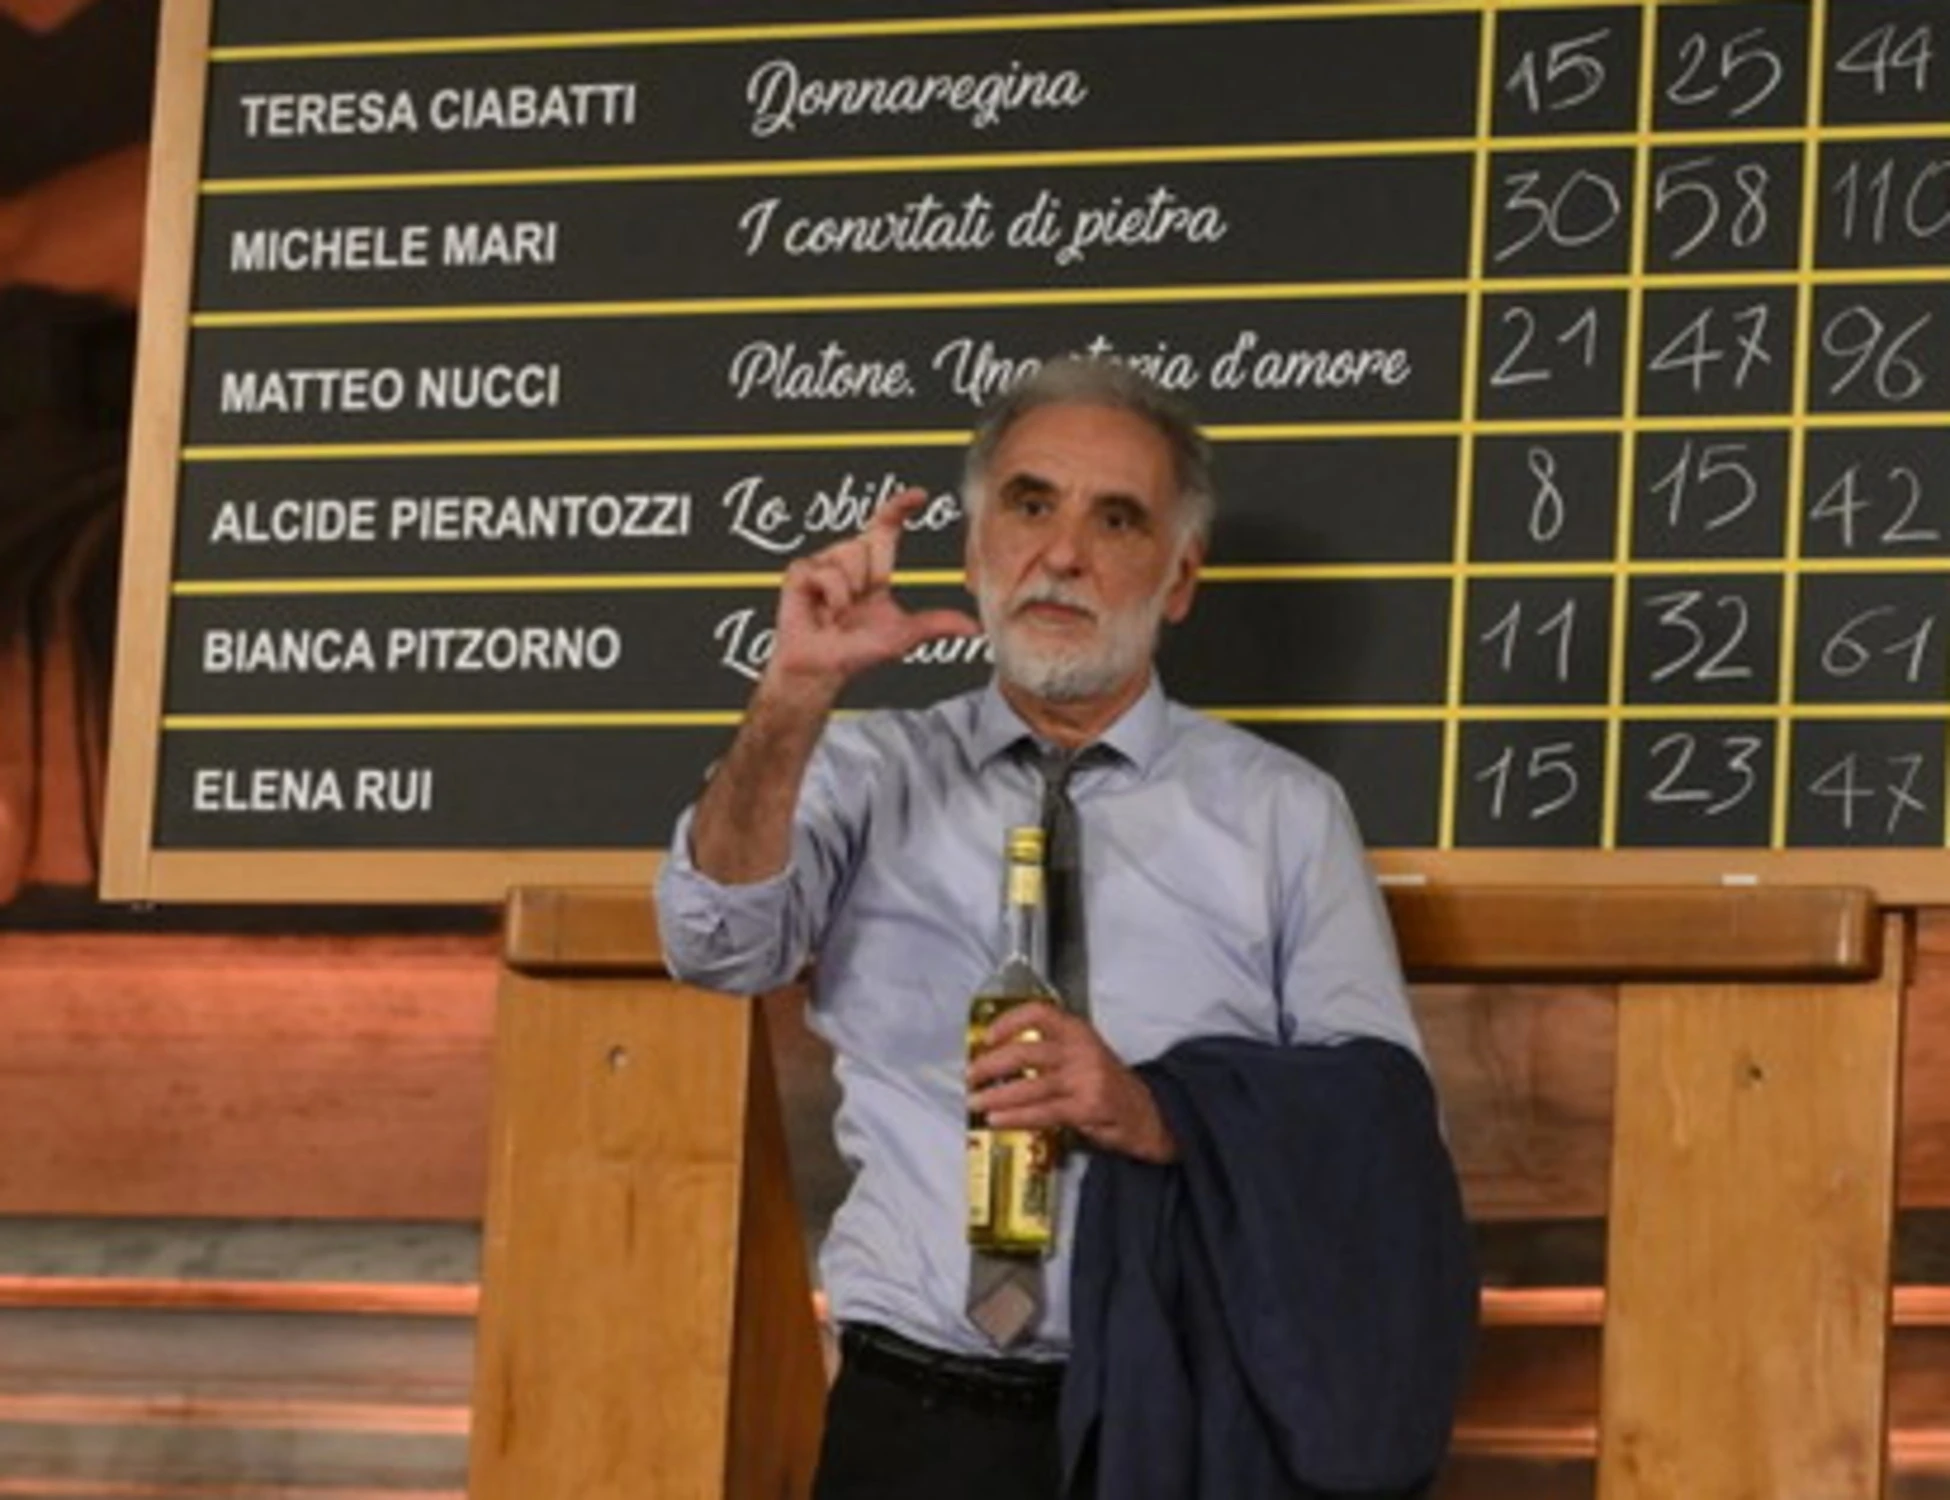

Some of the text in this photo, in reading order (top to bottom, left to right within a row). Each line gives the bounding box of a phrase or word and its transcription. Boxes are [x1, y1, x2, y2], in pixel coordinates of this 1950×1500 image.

[746, 60, 1088, 137] Donnaregina
[1506, 28, 1611, 113] 15
[1666, 27, 1783, 117] 25
[1835, 24, 1933, 94] 44
[240, 83, 636, 137] TERESA CIABATTI
[738, 186, 1227, 265] I convitati di pietra
[1494, 169, 1621, 262] 30
[1654, 157, 1769, 260] 58
[1832, 157, 1950, 243] 110
[230, 221, 557, 271] MICHELE MARI
[728, 341, 916, 399] Platone.
[1210, 331, 1411, 390] d'amore
[1489, 306, 1598, 387] 21
[1648, 303, 1772, 392] 47
[1821, 305, 1932, 400] 96
[220, 364, 560, 413] MATTEO NUCCI
[210, 494, 692, 542] ALCIDE PIERANTOZZI
[723, 473, 963, 552] Lo sbilo
[1528, 446, 1565, 542] 8
[1650, 440, 1757, 530] 15
[1809, 464, 1940, 548] 42
[203, 626, 621, 672] BIANCA PITZORNO
[1480, 599, 1577, 682] 11
[1646, 590, 1753, 682] 32
[1821, 605, 1934, 682] 61
[193, 769, 433, 811] ELENA RUI
[1475, 742, 1578, 819] 15
[1648, 732, 1762, 816] 23
[1808, 752, 1927, 834] 47
